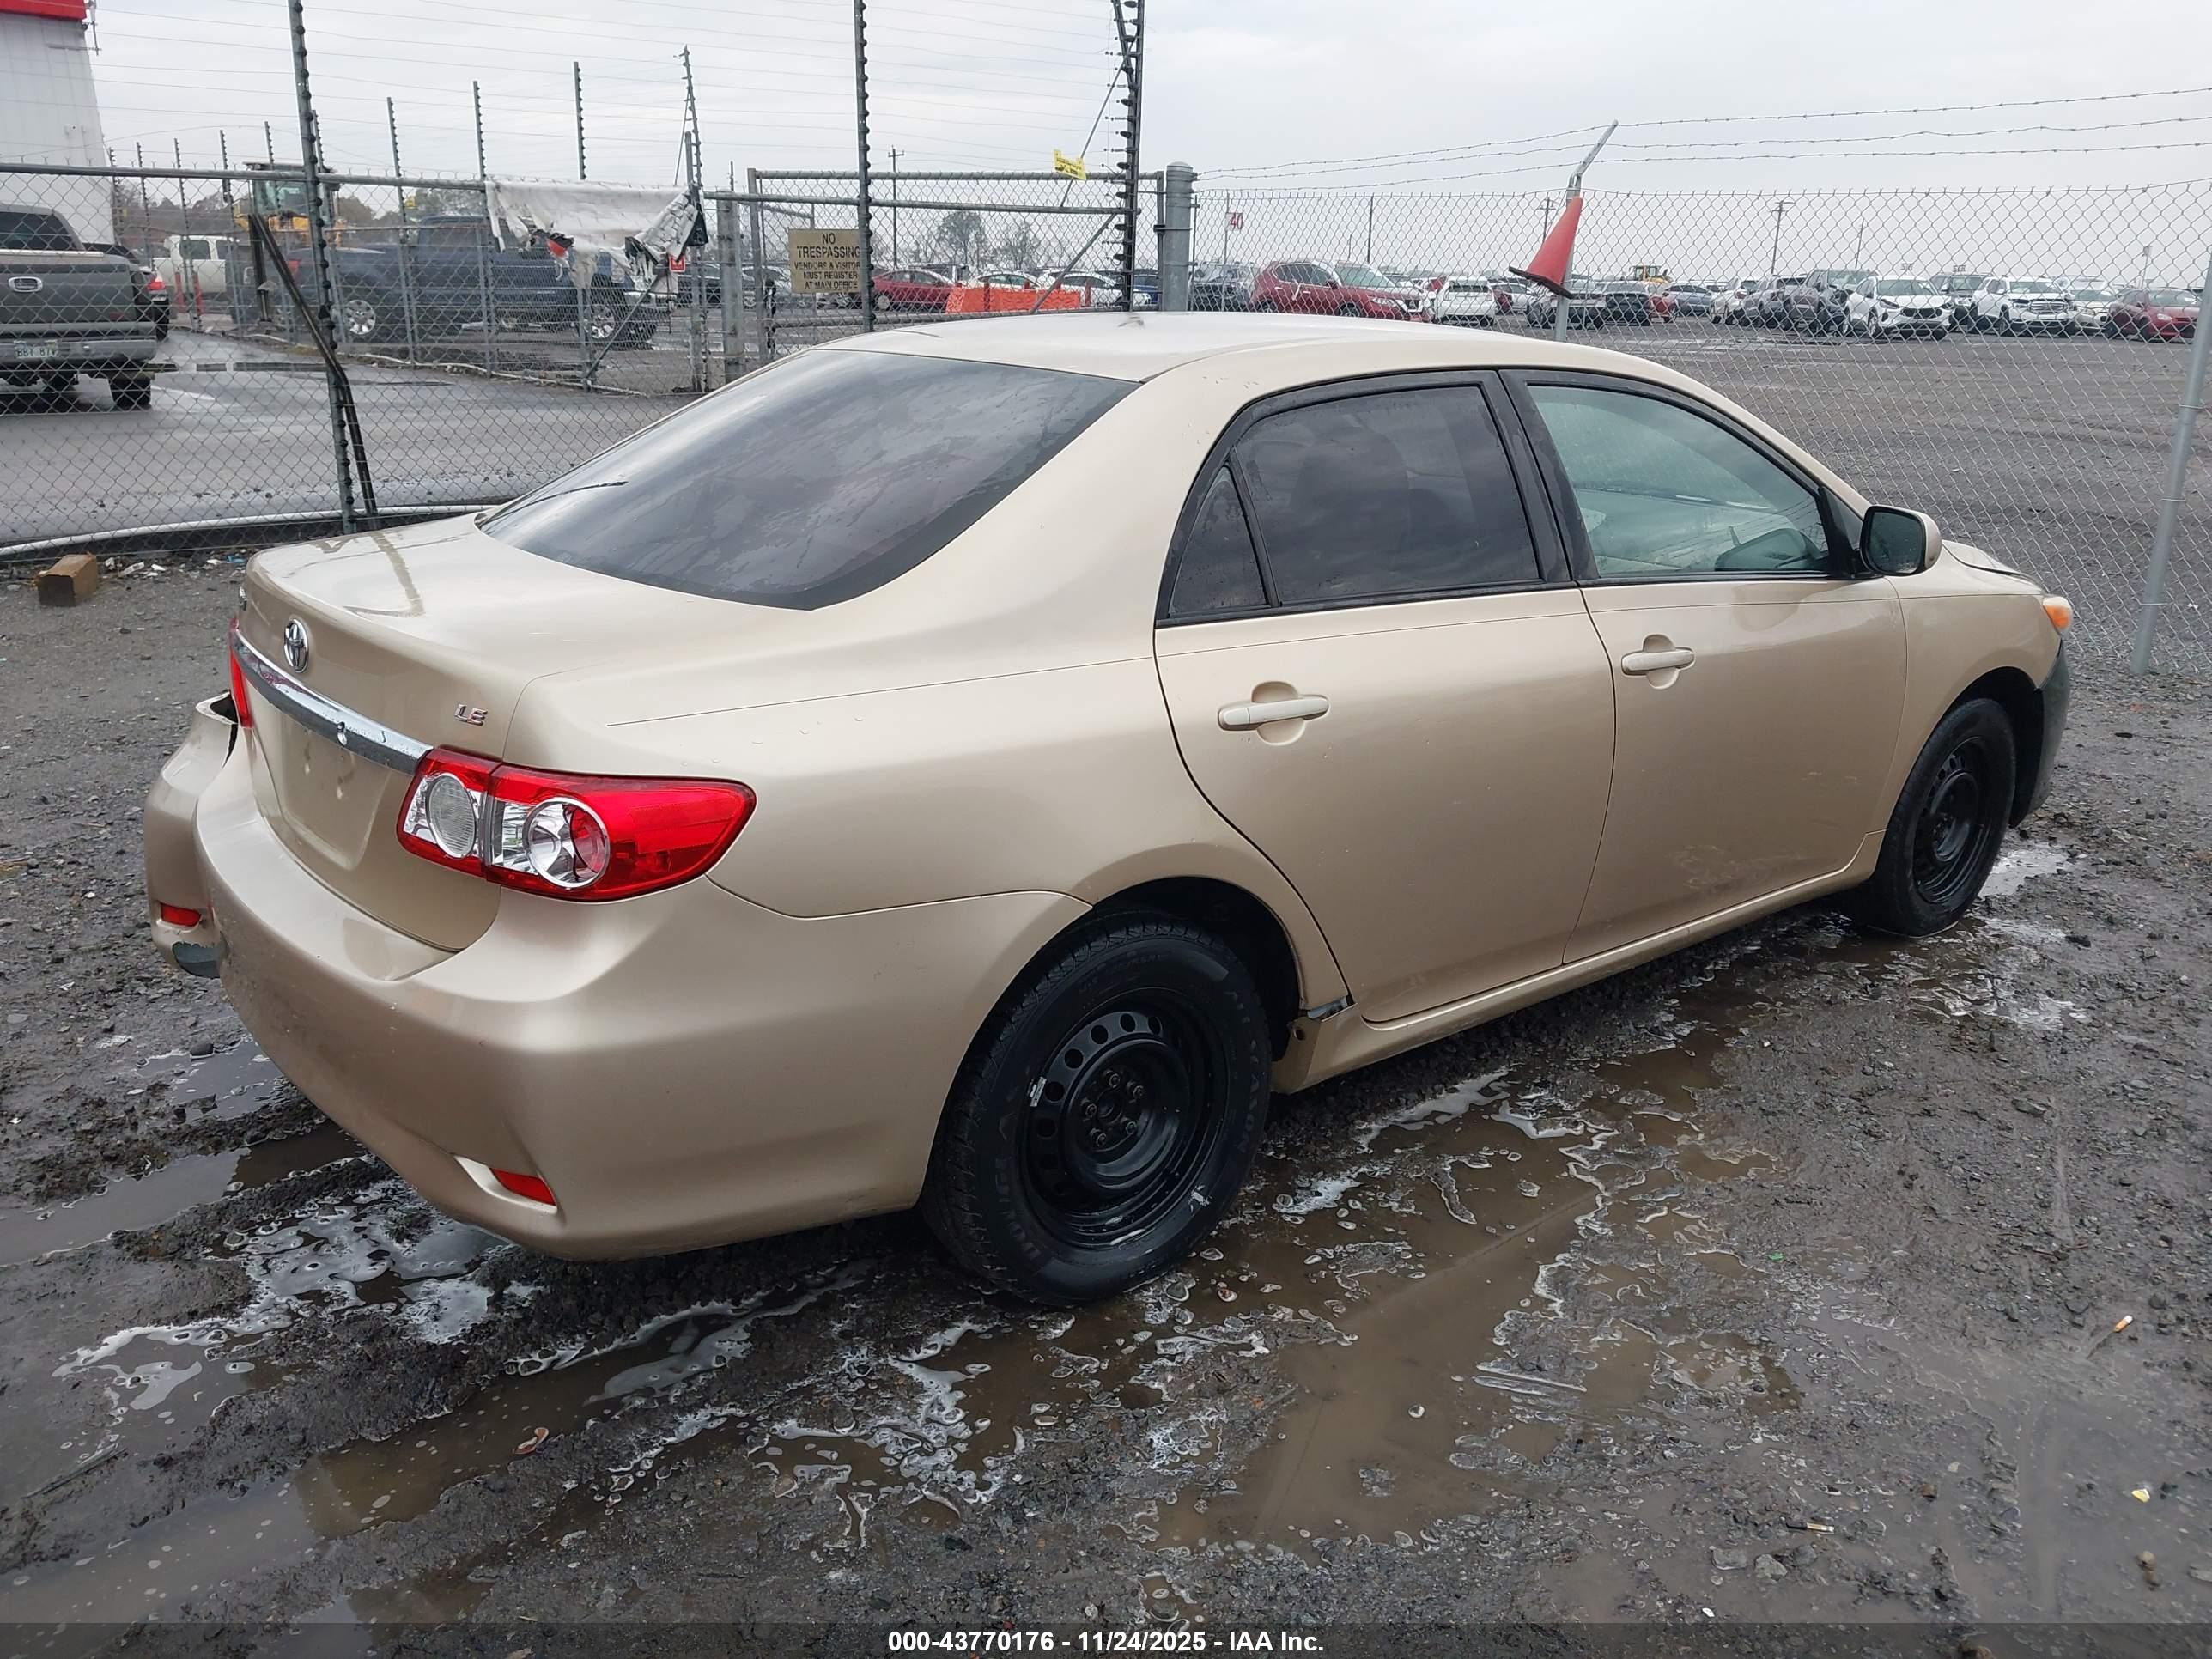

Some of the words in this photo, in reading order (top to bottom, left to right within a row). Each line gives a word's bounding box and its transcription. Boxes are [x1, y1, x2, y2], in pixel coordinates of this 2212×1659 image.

[822, 233, 836, 245] NO
[796, 246, 860, 258] TRESPASSING
[794, 261, 827, 270] VENDORS
[835, 261, 860, 270] VISITOR
[803, 271, 822, 280] MUST
[824, 271, 858, 280] REGISTER
[805, 281, 813, 289] AT
[815, 281, 832, 289] MAIN
[834, 280, 859, 289] OFFICE
[454, 703, 489, 726] LE
